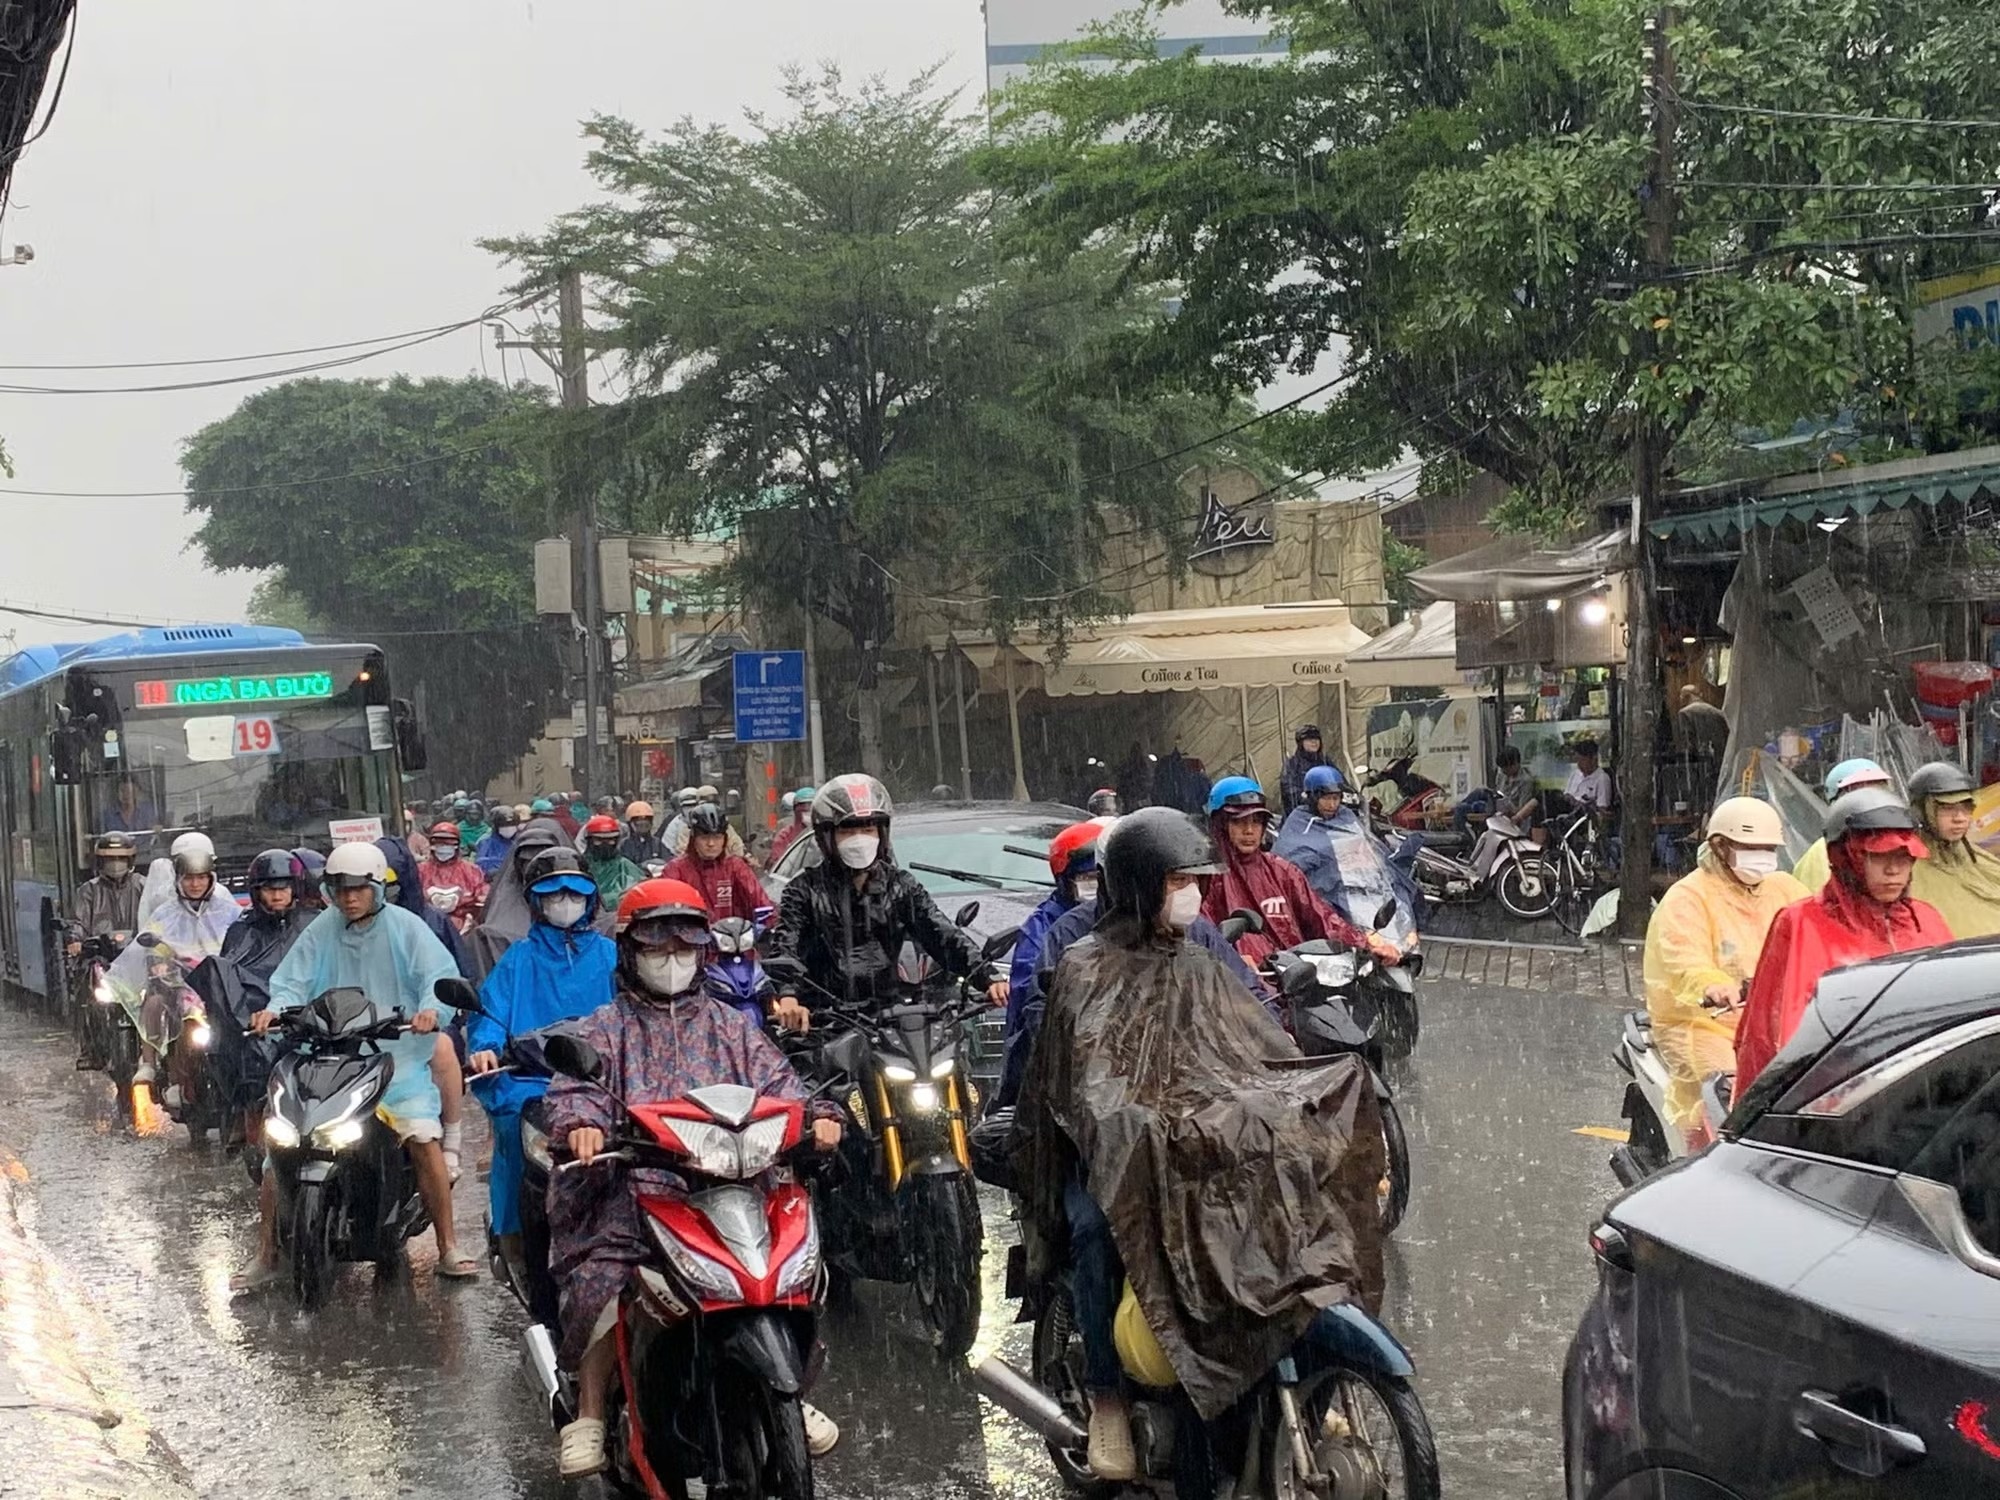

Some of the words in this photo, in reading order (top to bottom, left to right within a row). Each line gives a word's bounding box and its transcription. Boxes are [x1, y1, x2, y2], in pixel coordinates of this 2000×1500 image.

[1141, 668, 1181, 683] Coffee
[1184, 671, 1193, 681] &
[1194, 666, 1218, 680] Tea
[1292, 661, 1331, 675] Coffee
[1335, 663, 1344, 674] &
[239, 680, 273, 699] BA
[237, 719, 271, 751] 19
